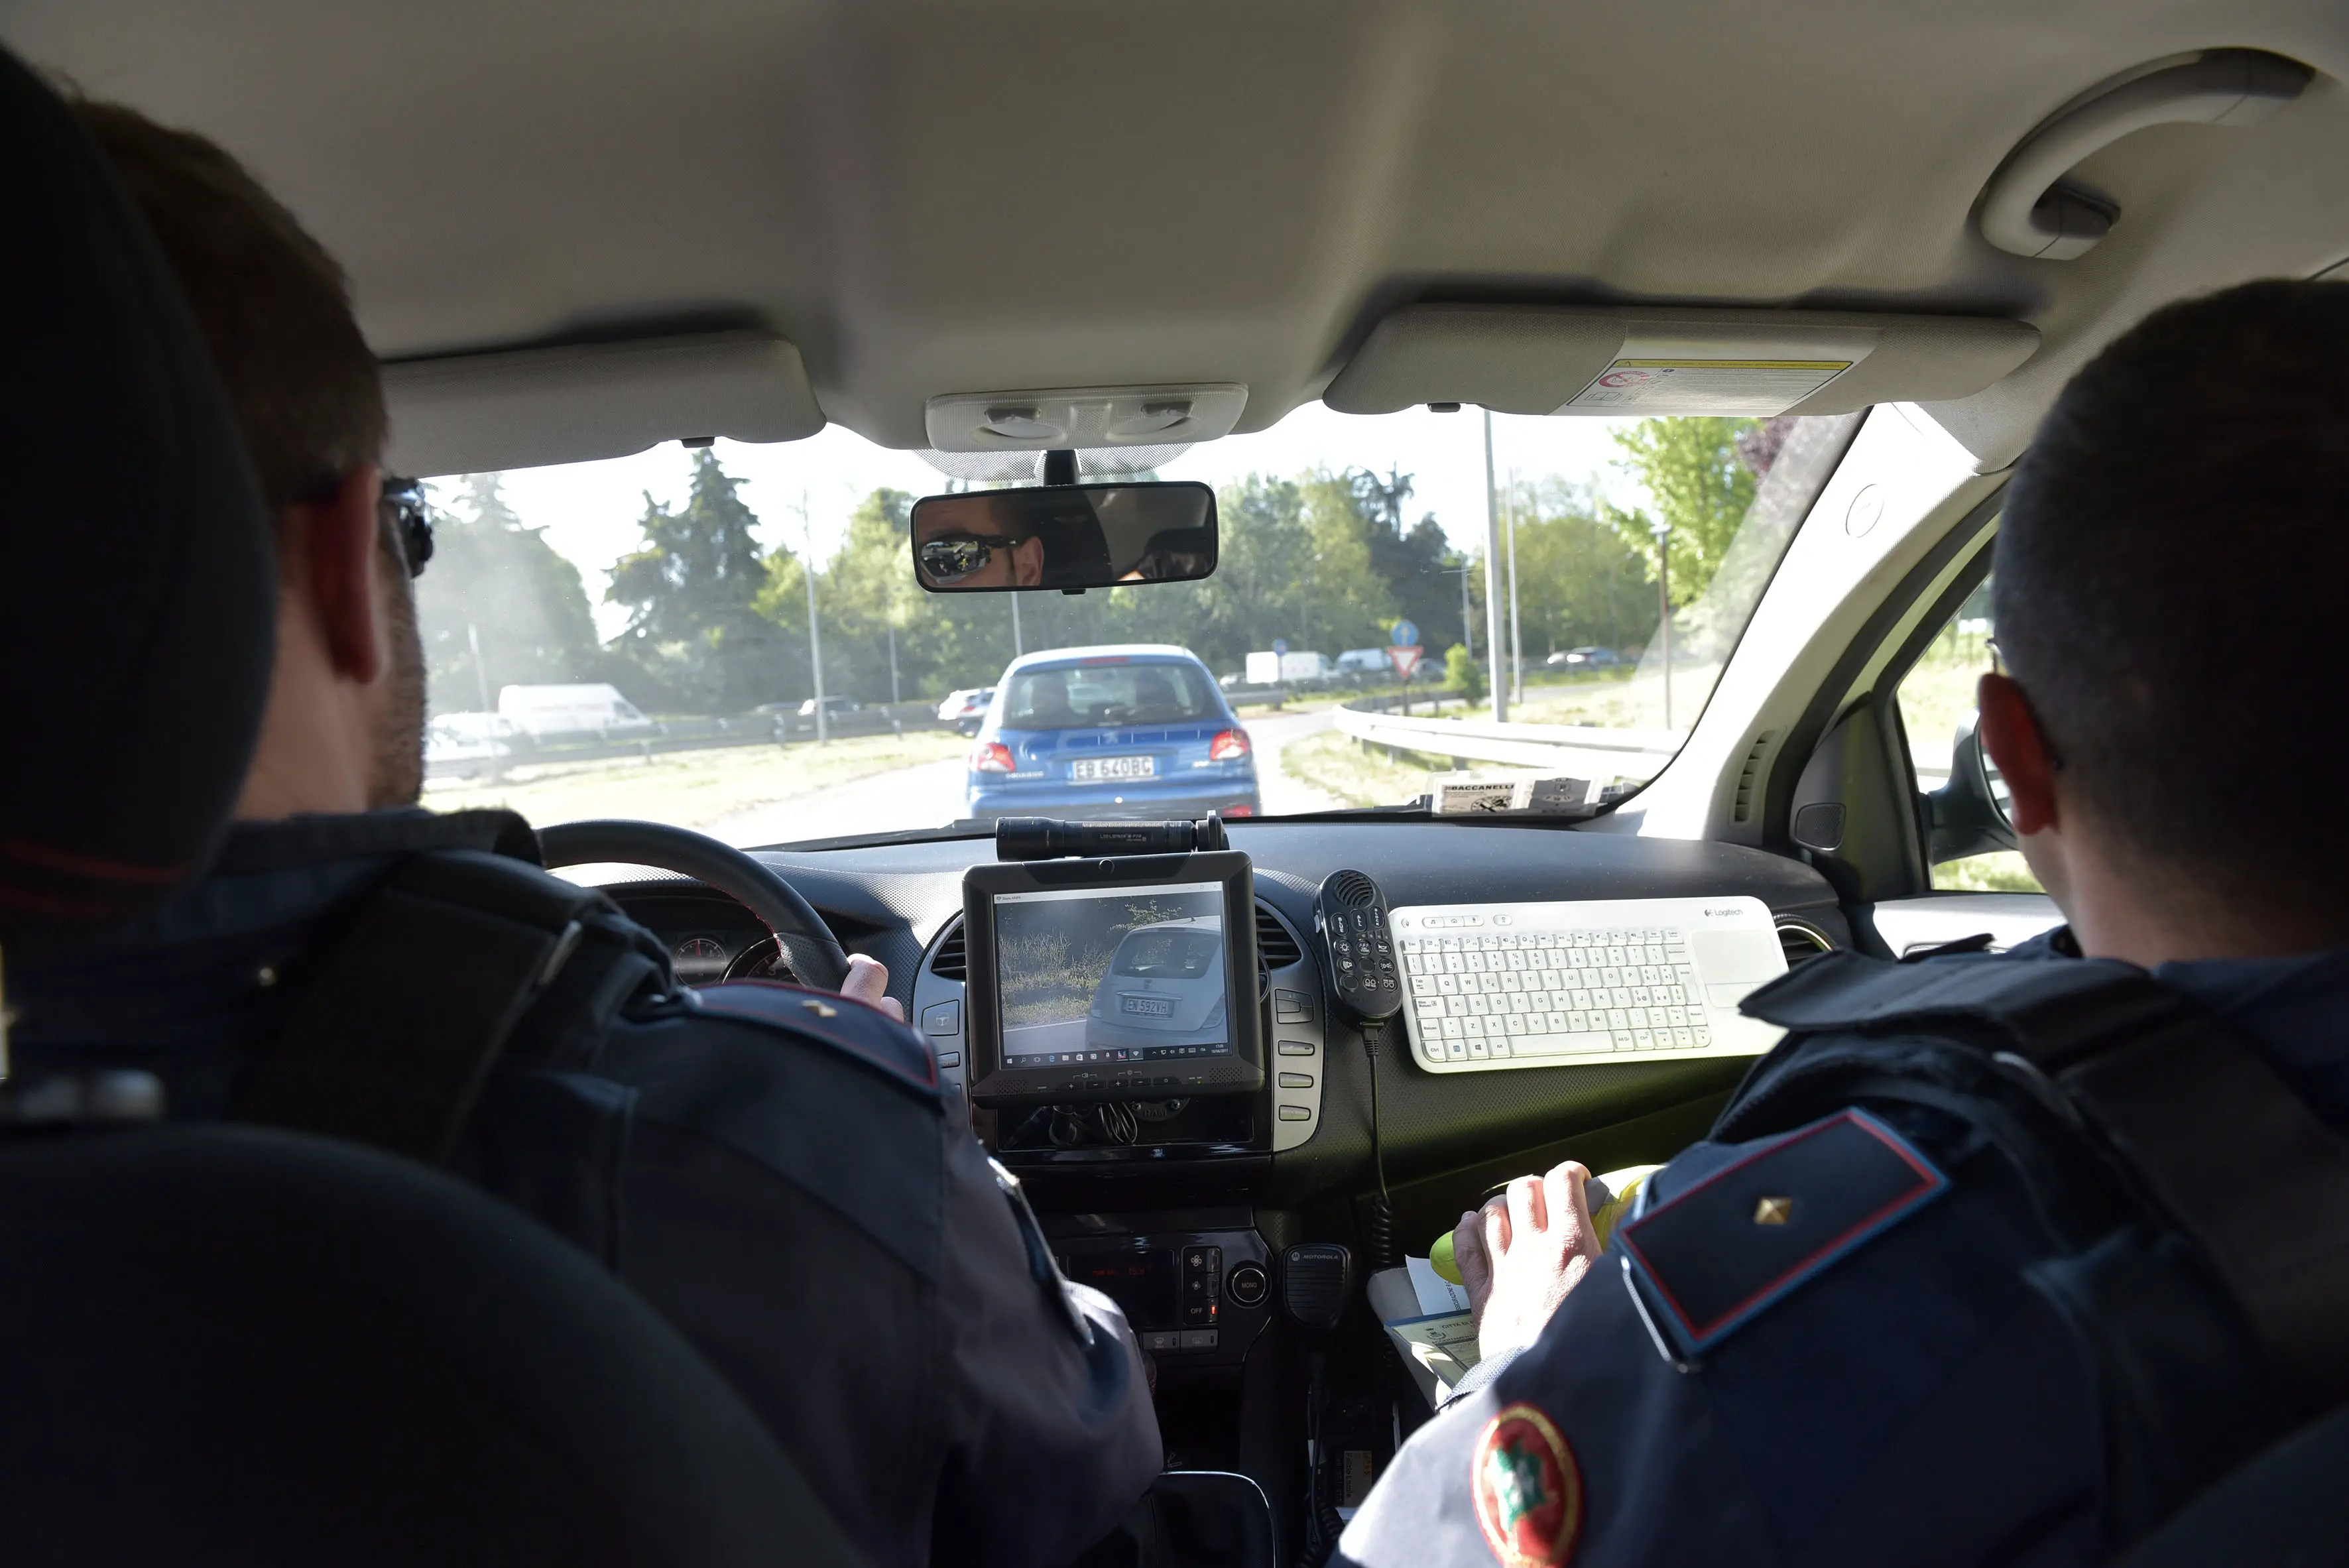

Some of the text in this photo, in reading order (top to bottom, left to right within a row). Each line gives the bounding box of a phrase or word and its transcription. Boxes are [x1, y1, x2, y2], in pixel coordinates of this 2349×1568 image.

[1075, 760, 1095, 779] EB
[768, 965, 776, 975] 3
[1144, 1108, 1168, 1117] RAM
